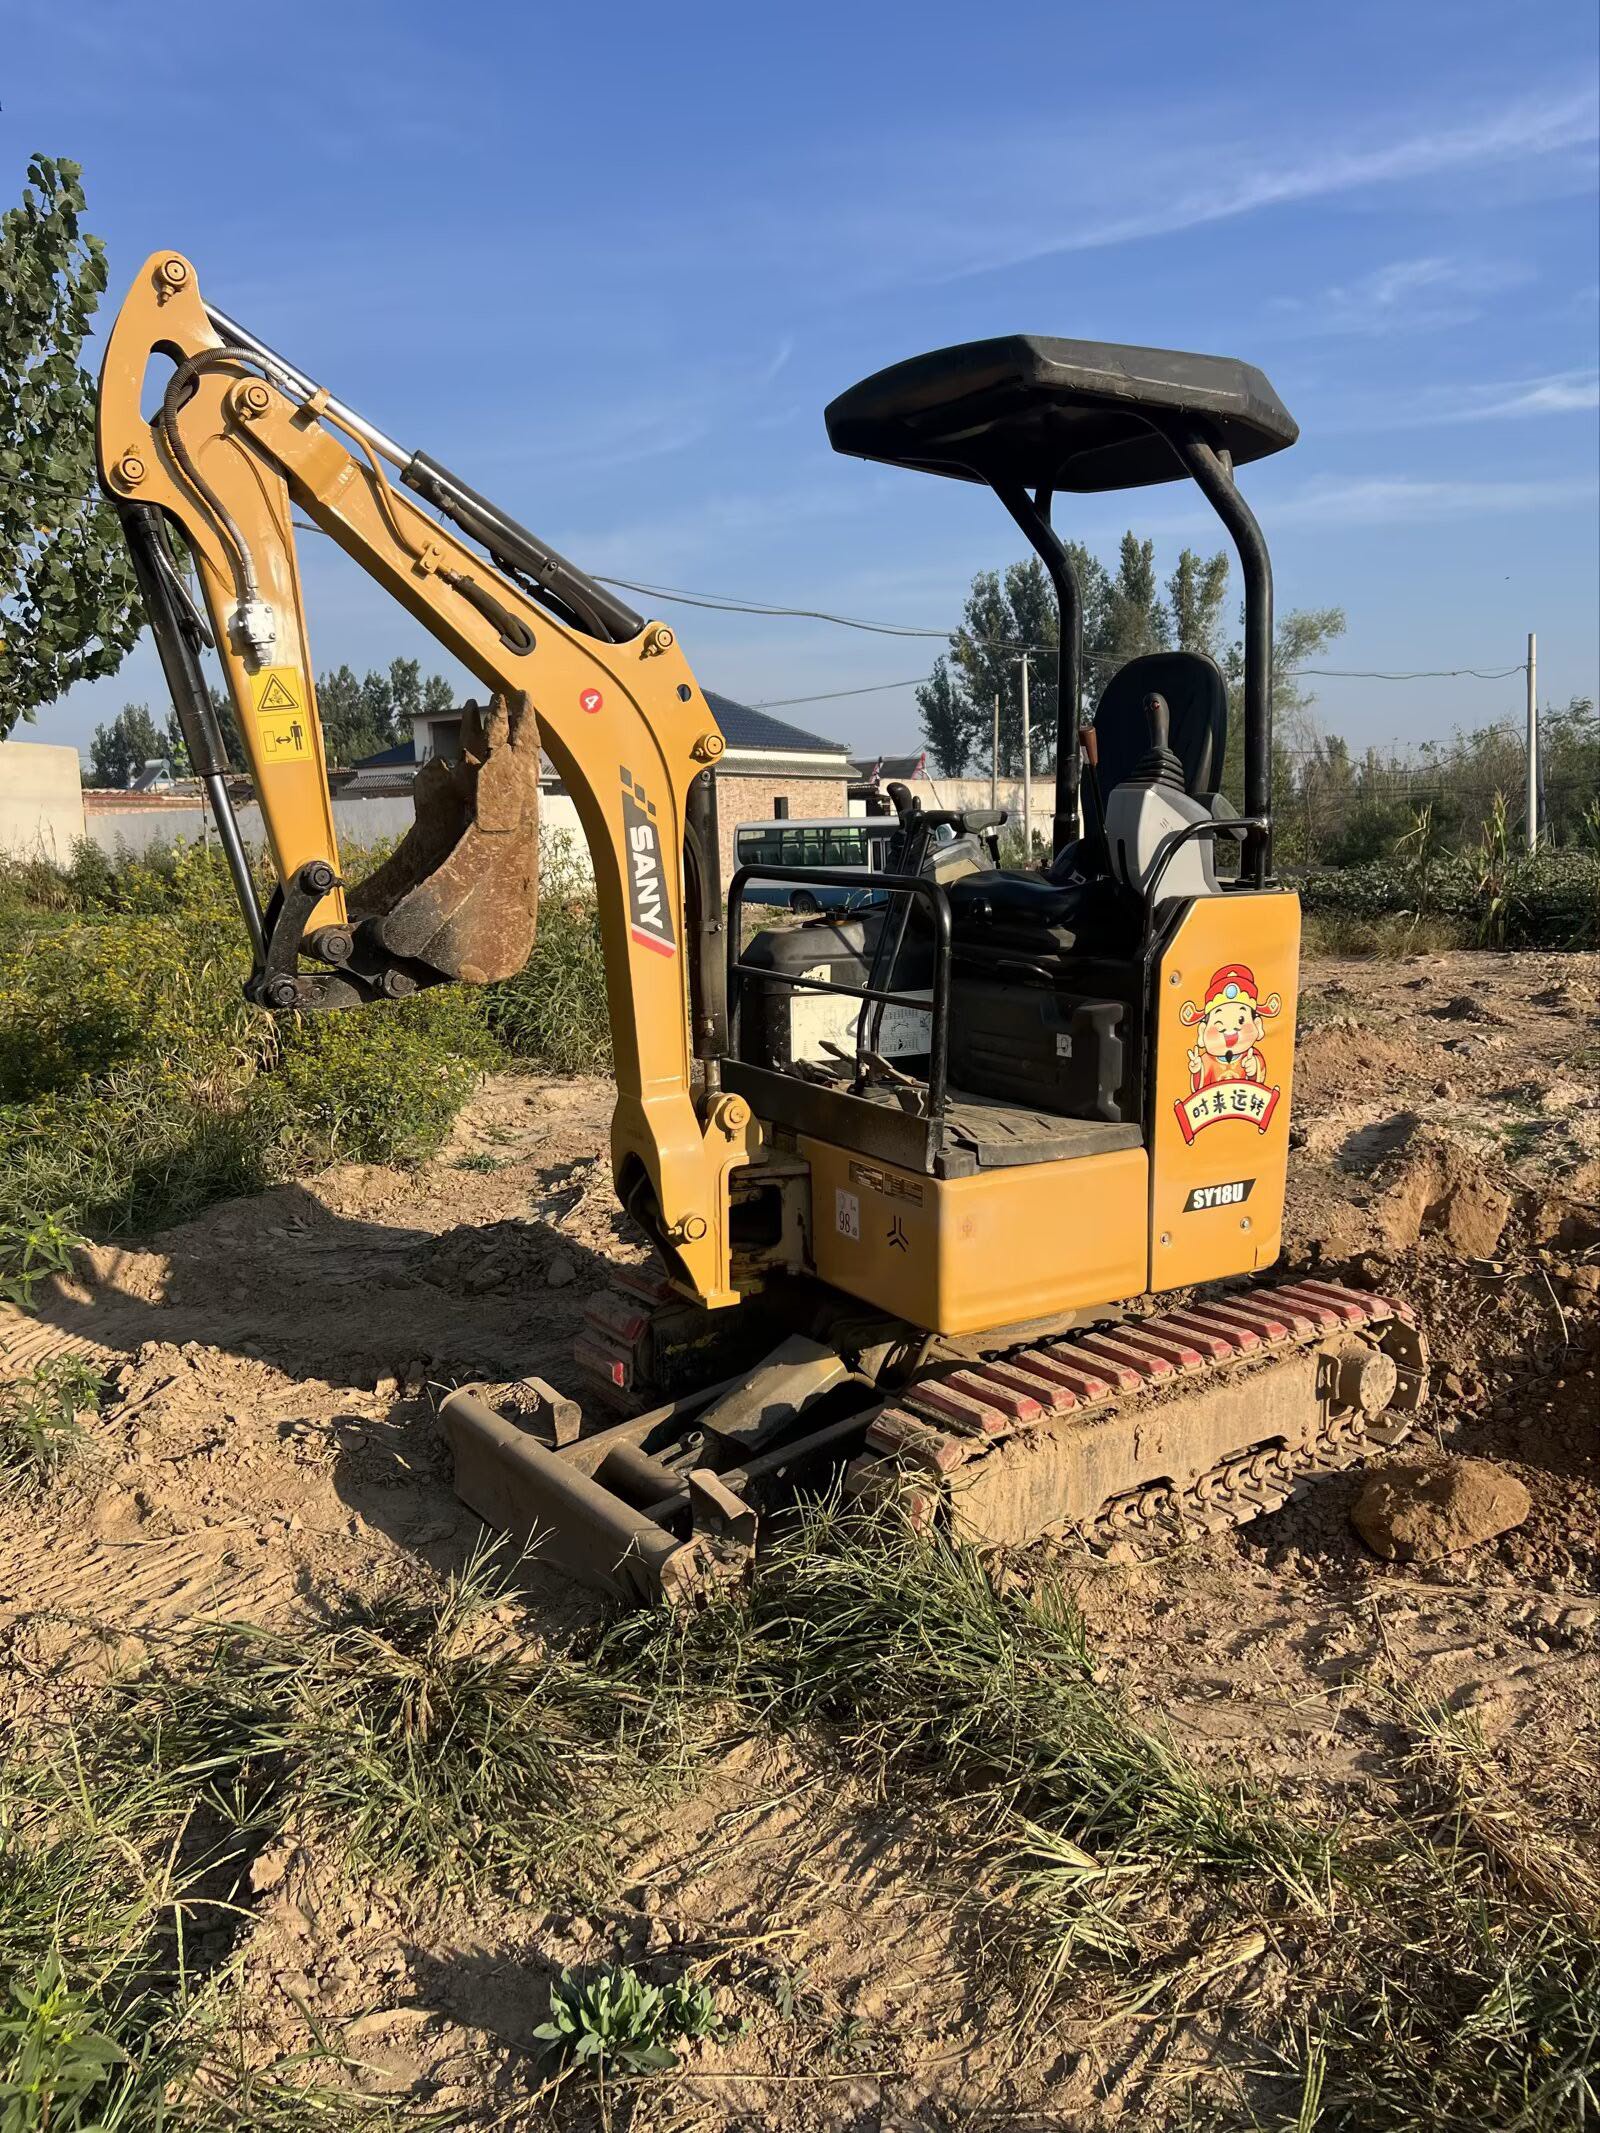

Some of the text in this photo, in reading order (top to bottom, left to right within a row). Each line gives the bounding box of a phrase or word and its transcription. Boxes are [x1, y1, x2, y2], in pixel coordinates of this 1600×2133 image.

[584, 694, 600, 711] 4
[629, 824, 664, 930] SANY
[1192, 1088, 1266, 1119] 时来运转
[1193, 1182, 1244, 1209] SY18U
[839, 1210, 851, 1233] 98
